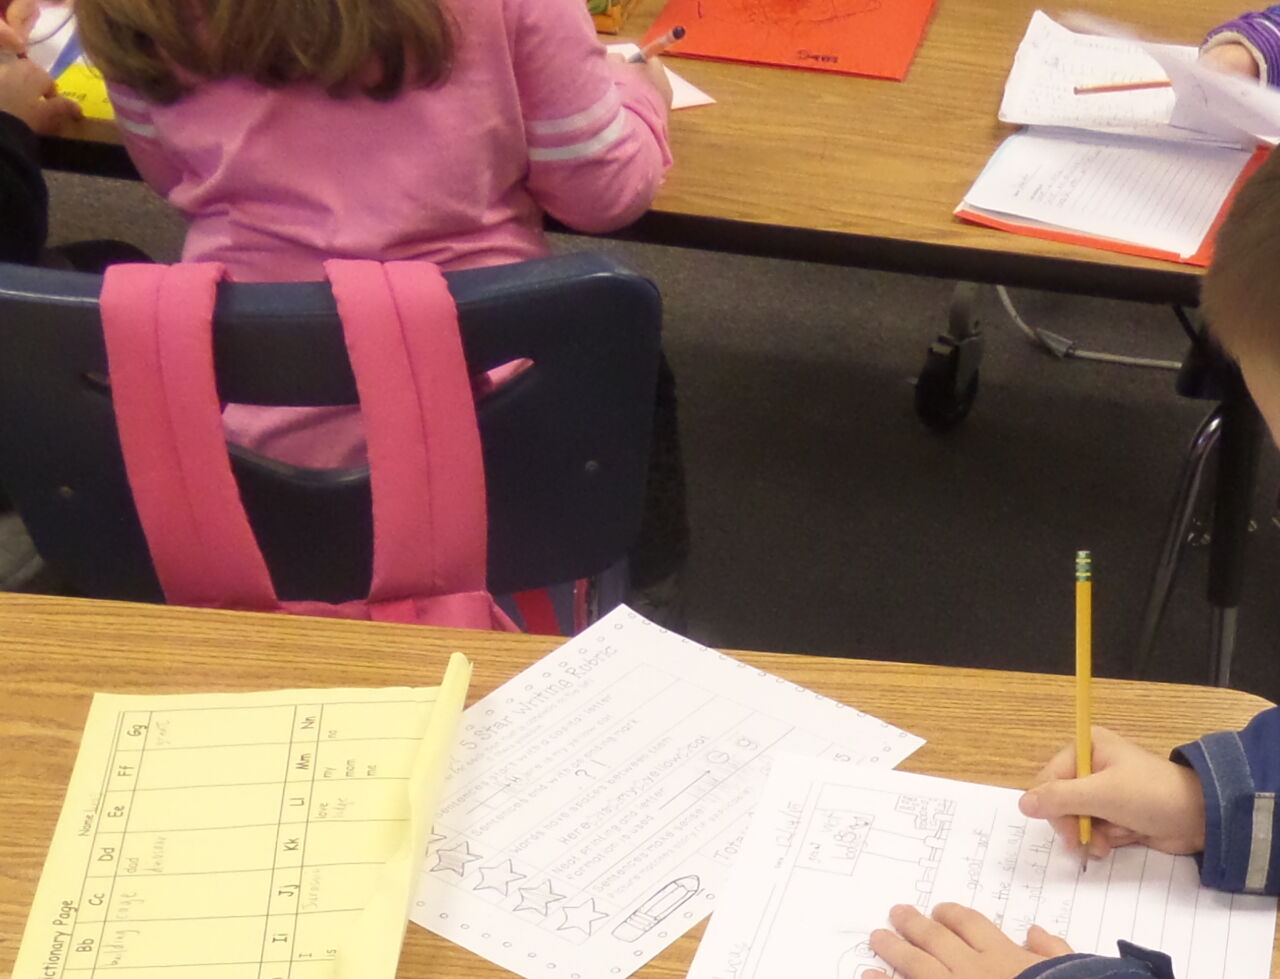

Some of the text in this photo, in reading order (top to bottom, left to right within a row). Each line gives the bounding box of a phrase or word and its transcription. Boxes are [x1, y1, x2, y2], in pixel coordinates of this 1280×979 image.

[474, 715, 512, 741] Star
[512, 678, 573, 715] Writing
[565, 645, 617, 679] Rubric
[300, 716, 315, 730] Nn
[295, 753, 310, 770] Mm
[75, 938, 94, 953] Bb
[88, 893, 105, 906] Cc
[97, 847, 115, 862] Dd
[107, 805, 125, 818] Ee
[117, 765, 134, 777] Ff
[126, 724, 147, 737] Gg
[559, 821, 591, 845] Here
[284, 838, 299, 851] Kk
[278, 884, 299, 897] Jj
[52, 900, 80, 929] Page
[271, 933, 288, 944] Ii
